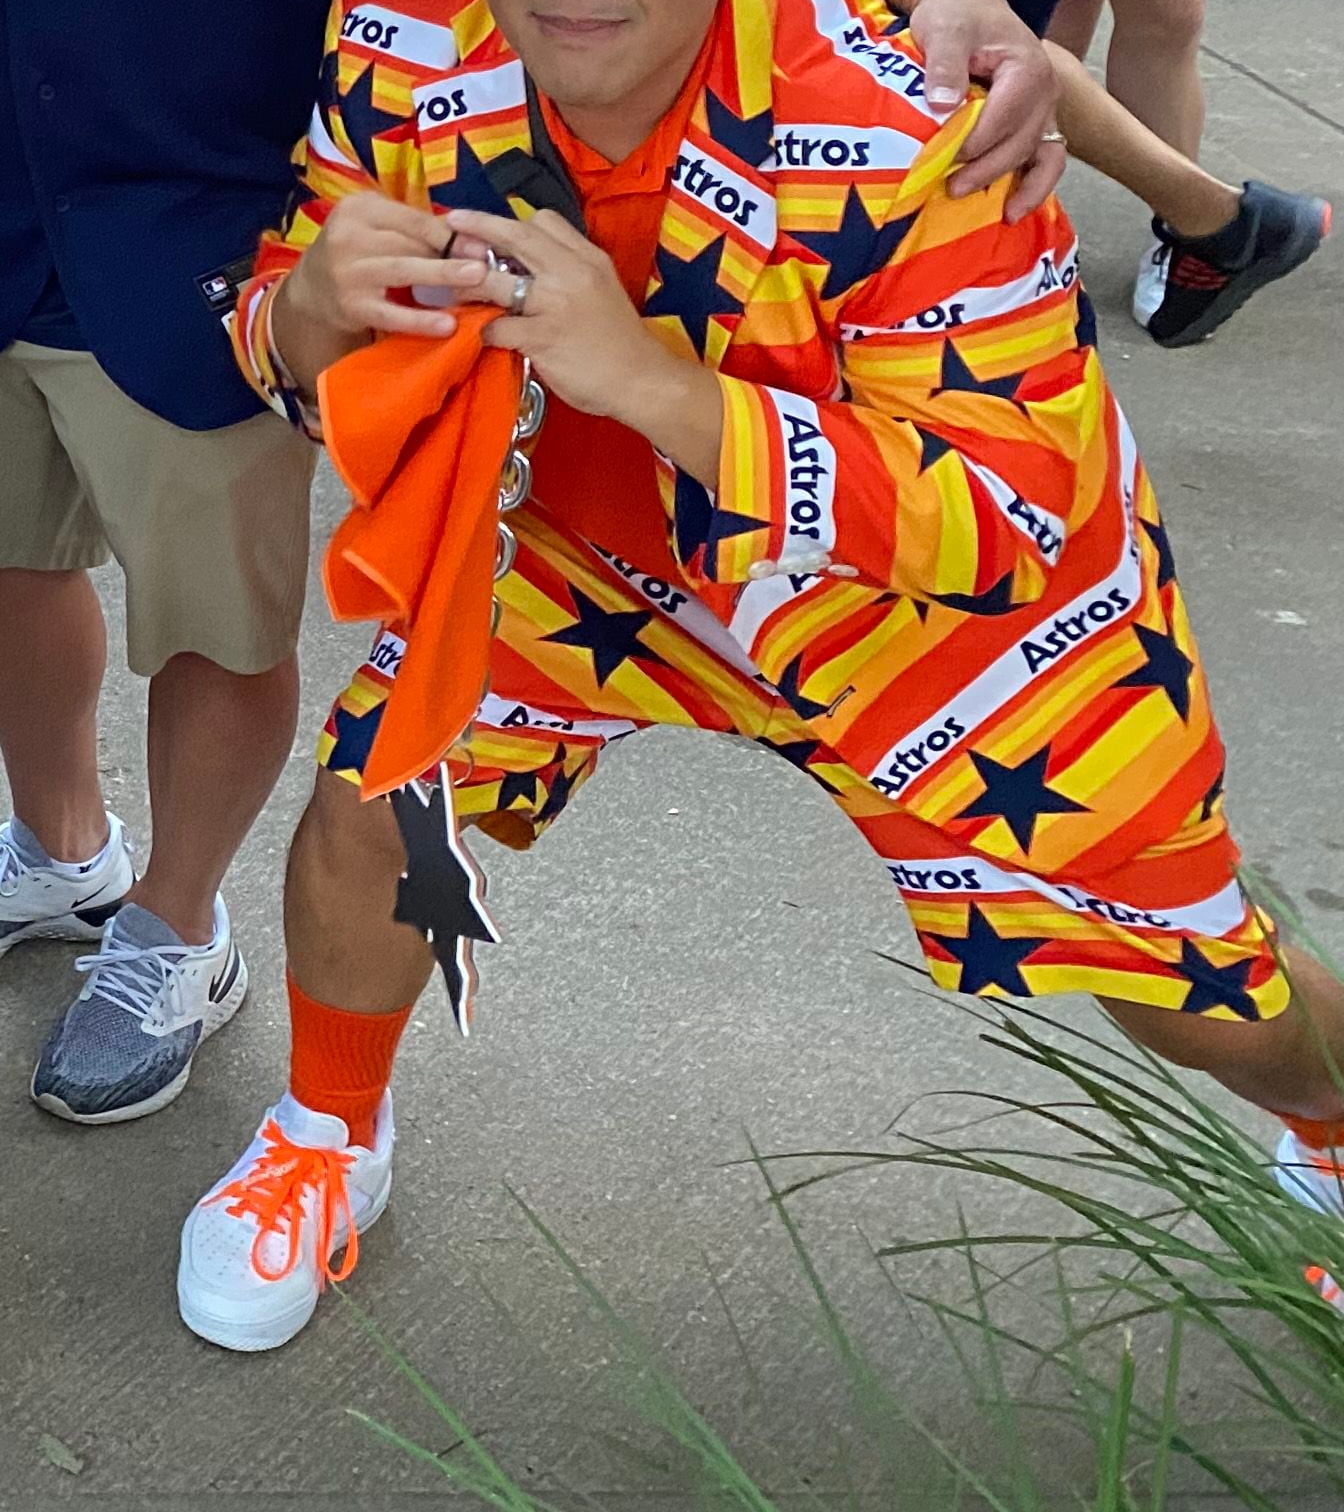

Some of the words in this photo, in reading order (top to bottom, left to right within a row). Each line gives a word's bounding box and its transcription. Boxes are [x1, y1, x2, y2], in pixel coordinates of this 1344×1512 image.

[340, 9, 400, 50] tros
[416, 88, 468, 122] ros
[775, 130, 871, 167] stros
[672, 153, 760, 227] stros
[783, 412, 824, 542] Astros
[589, 540, 689, 615] tros
[1019, 587, 1131, 675] Astros
[868, 715, 967, 797] Astros
[886, 864, 982, 890] stros
